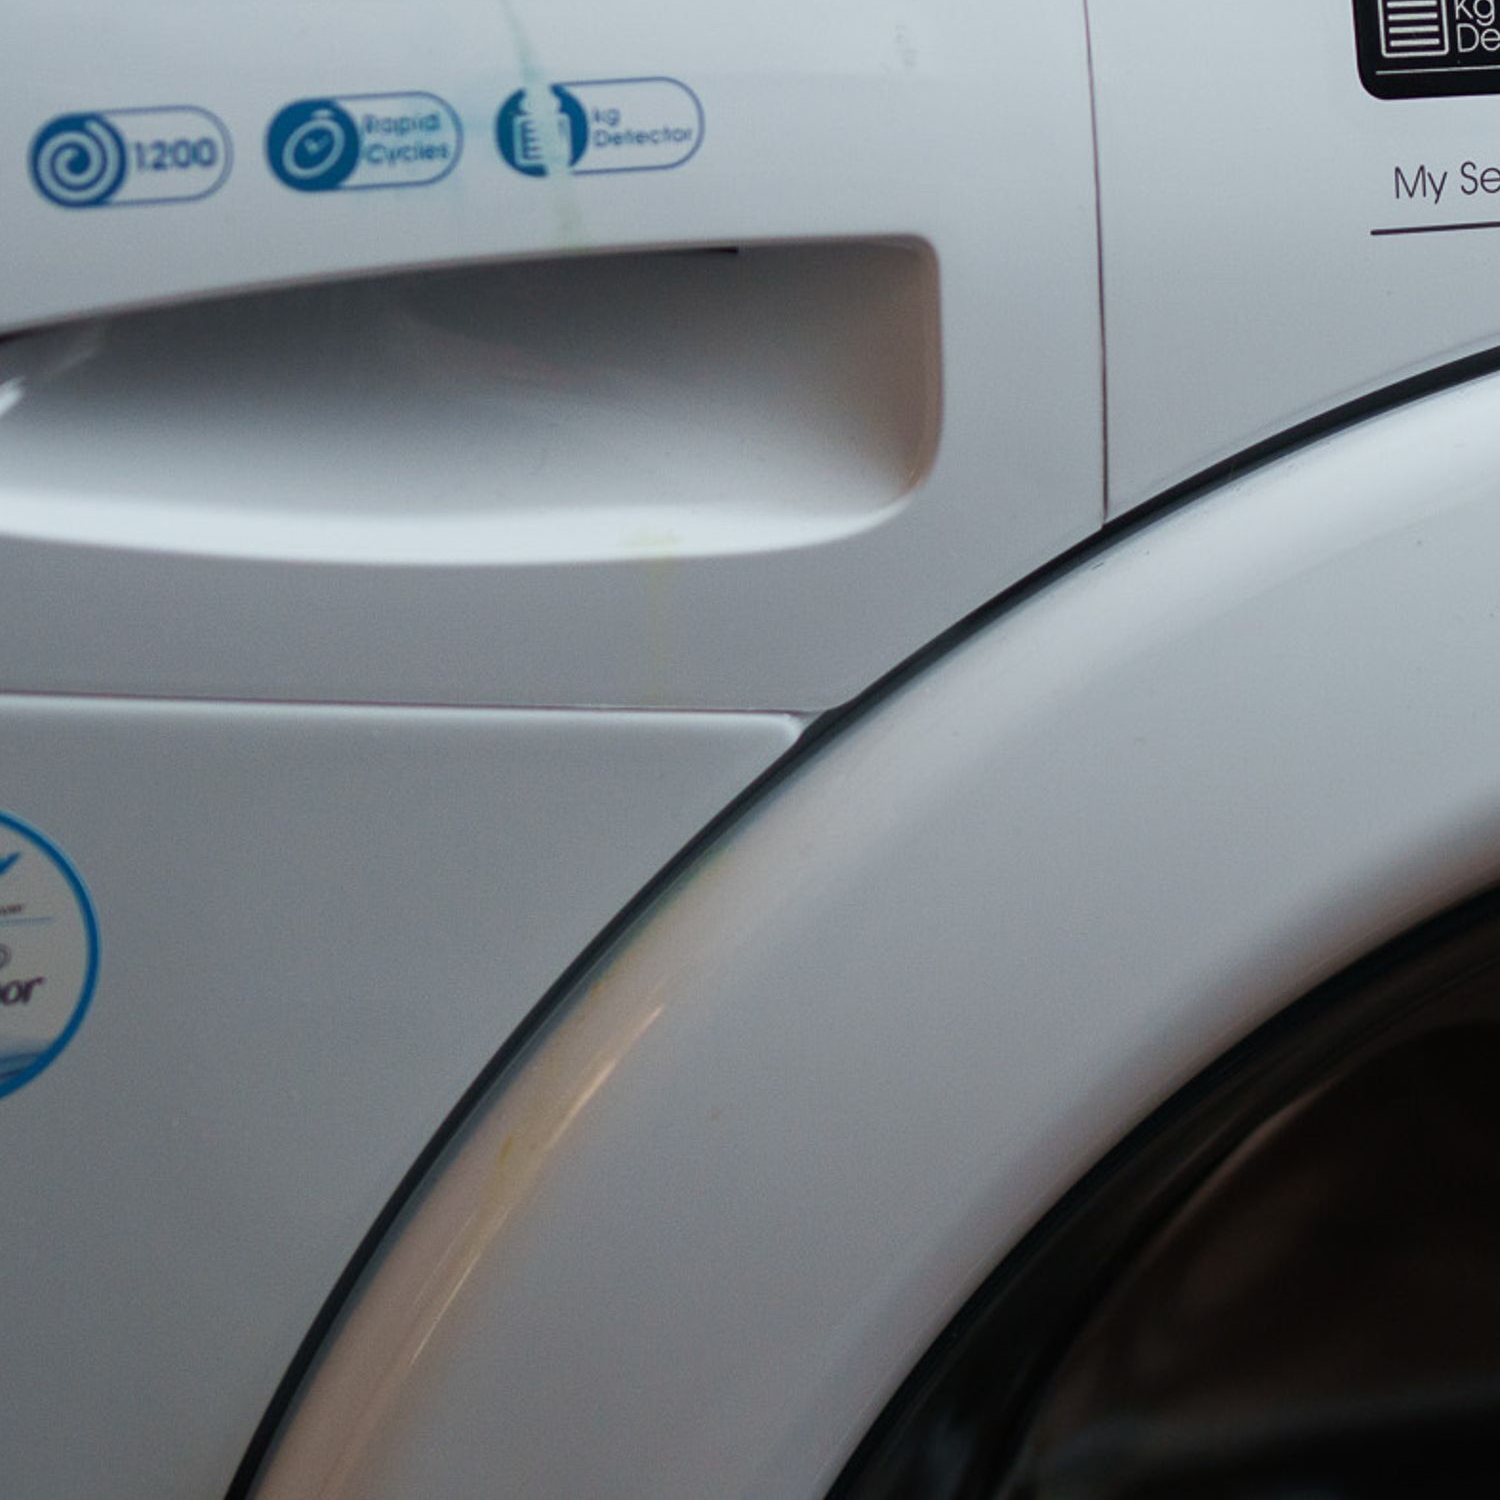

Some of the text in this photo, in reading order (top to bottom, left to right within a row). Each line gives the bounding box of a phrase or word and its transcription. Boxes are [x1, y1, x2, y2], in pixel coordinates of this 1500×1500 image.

[363, 111, 441, 137] Rapid
[592, 125, 693, 148] Detector
[135, 137, 219, 171] 1200
[366, 142, 449, 168] Cycles
[1393, 164, 1448, 204] My
